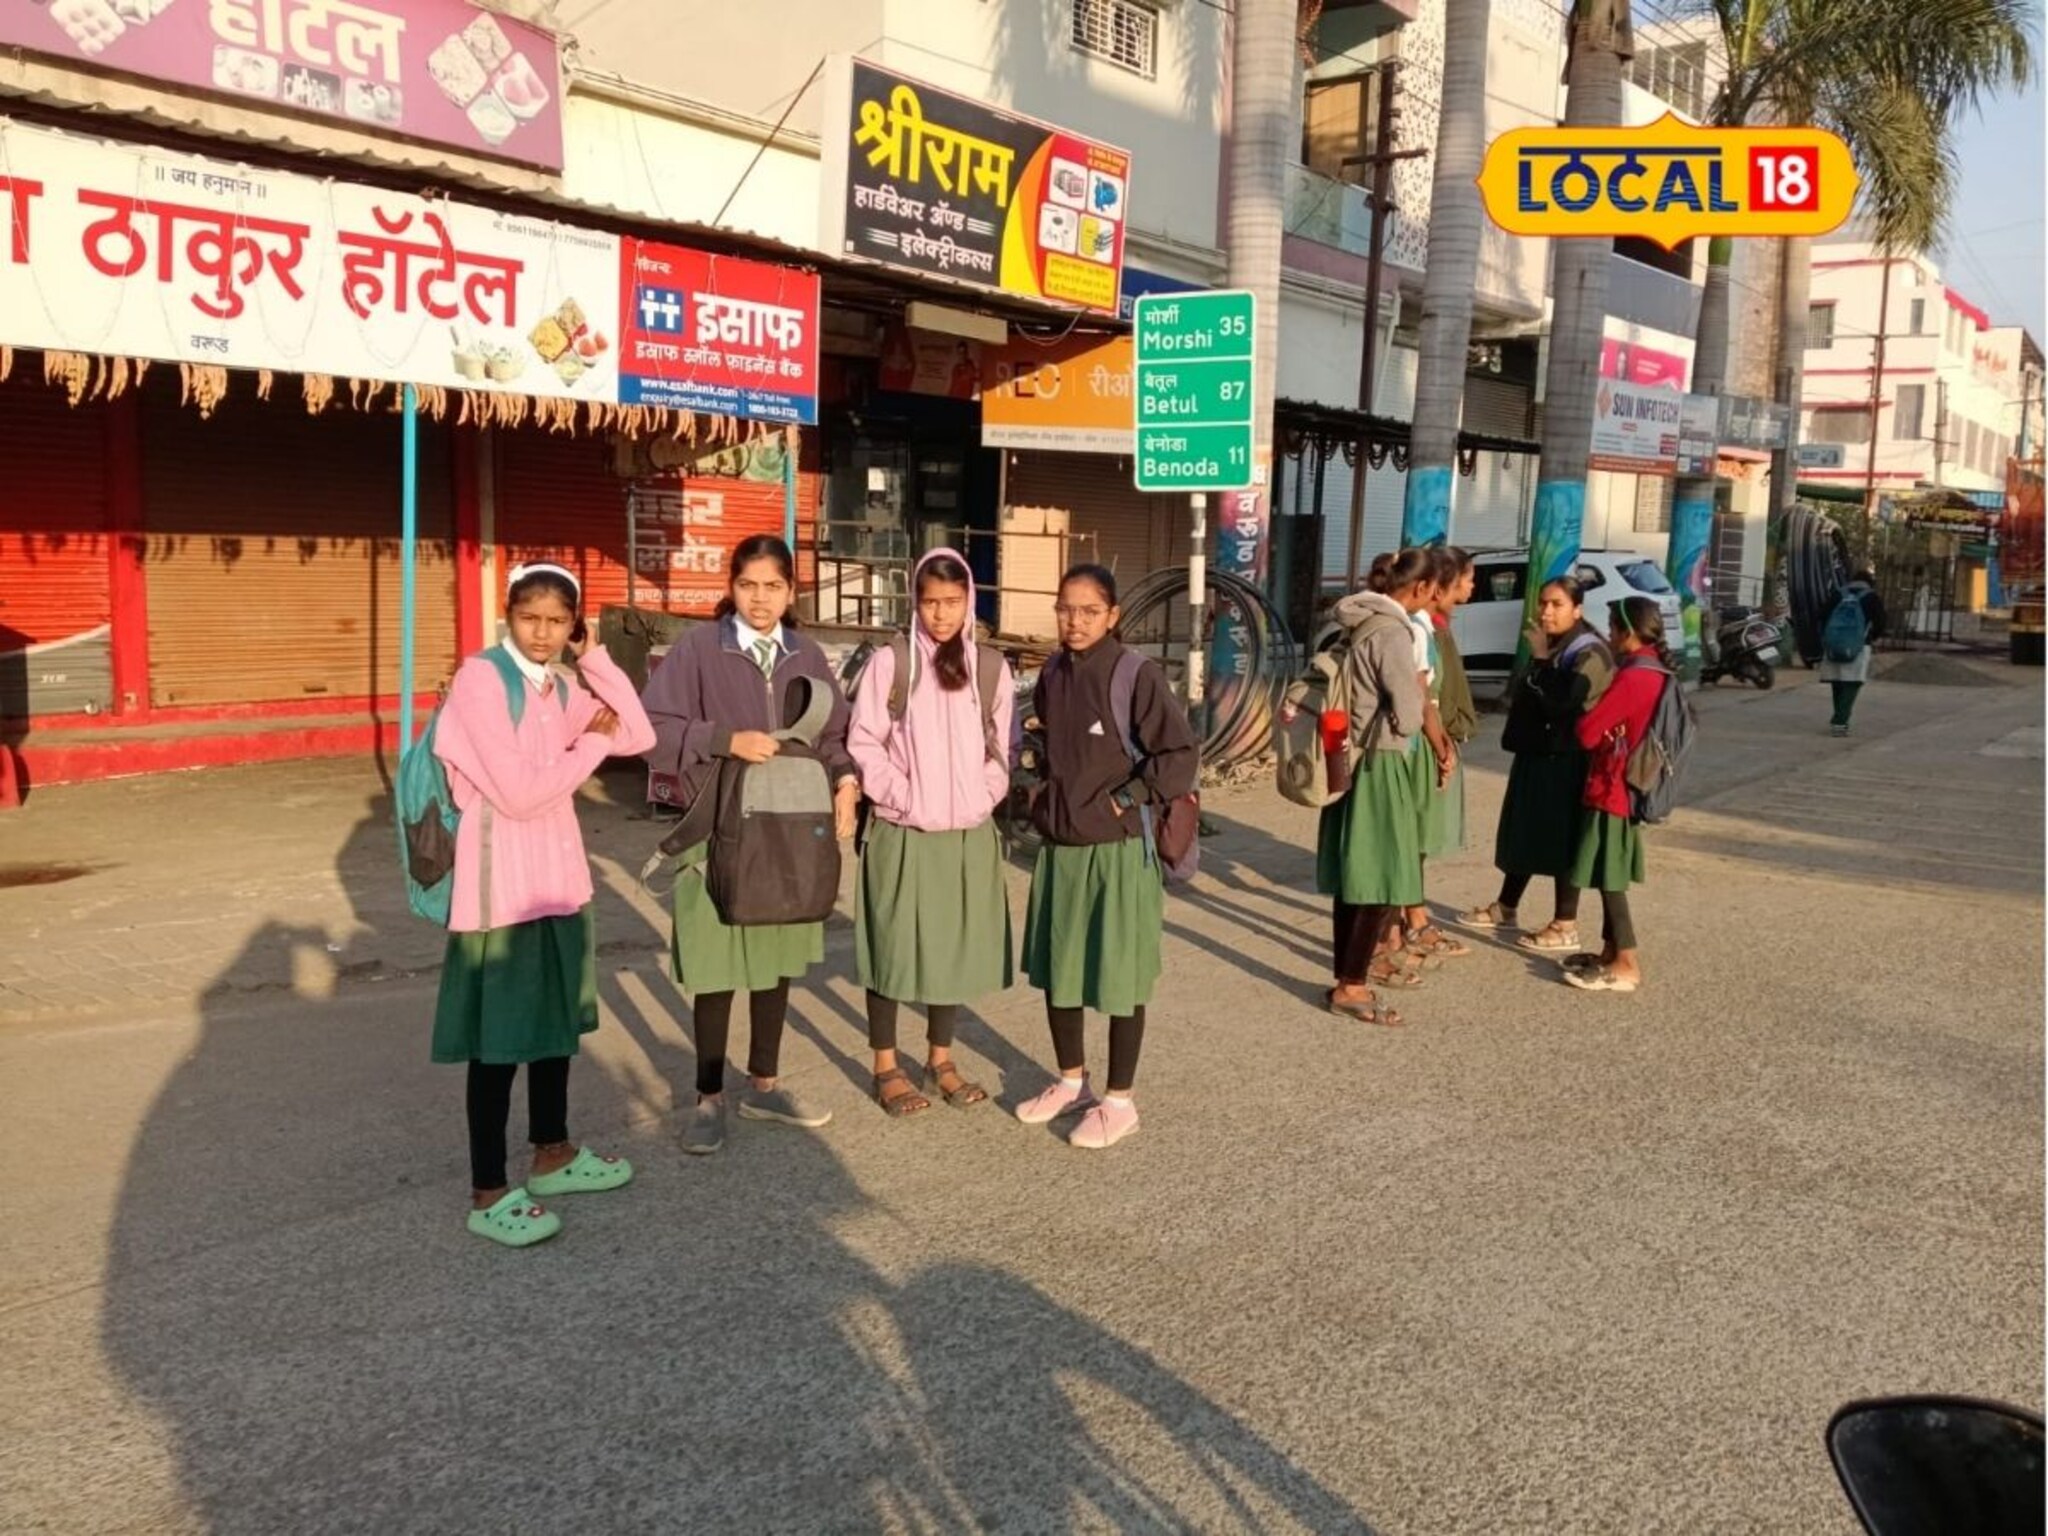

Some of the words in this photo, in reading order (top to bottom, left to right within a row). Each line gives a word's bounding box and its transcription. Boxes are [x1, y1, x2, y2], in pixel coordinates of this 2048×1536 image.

[855, 85, 1015, 208] श्रीराम
[171, 168, 197, 186] जय
[854, 184, 925, 221] हार्डवेअर
[78, 188, 310, 318] ठाकुर
[338, 205, 524, 327] हॉटेल
[692, 291, 805, 351] इसाफ
[1145, 304, 1179, 325] मोर्शी
[190, 334, 229, 353] वरूड
[1143, 330, 1213, 350] Morshi
[1219, 316, 1246, 336] 35
[635, 341, 679, 361] इसाफ
[640, 378, 738, 398] www.esafbank.com
[1143, 394, 1199, 415] Betul
[1219, 382, 1245, 401] 87
[1612, 393, 1635, 418] SUN
[1636, 398, 1680, 424] INFOTECH
[1143, 458, 1219, 477] Benoda
[1228, 446, 1245, 464] 11
